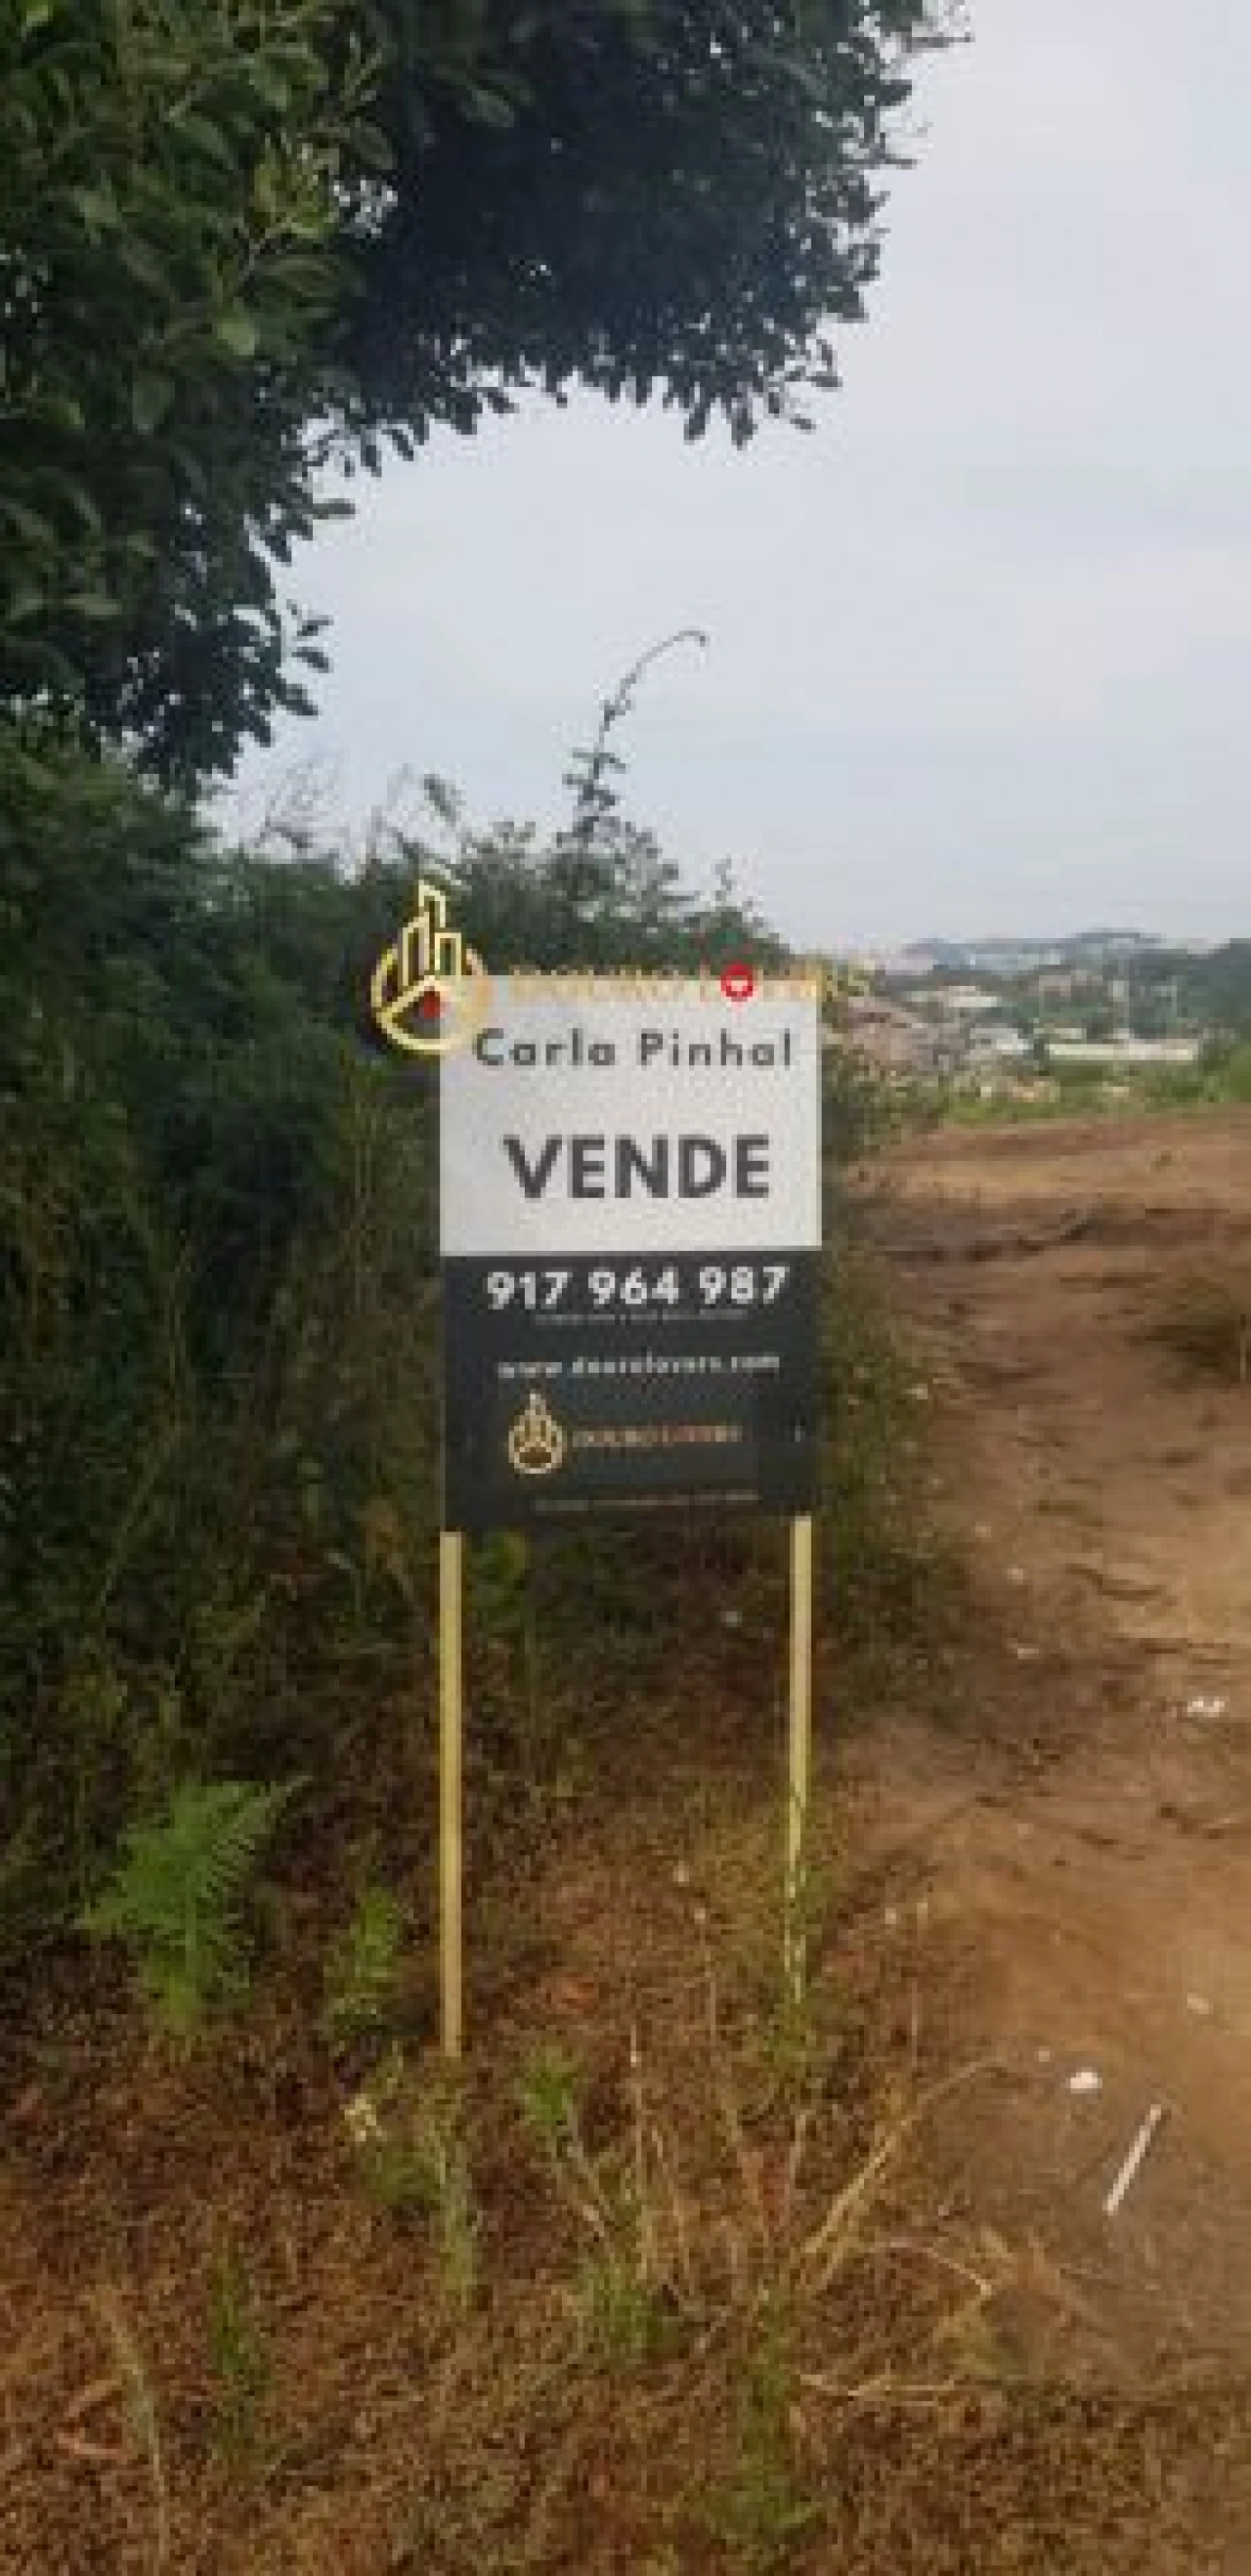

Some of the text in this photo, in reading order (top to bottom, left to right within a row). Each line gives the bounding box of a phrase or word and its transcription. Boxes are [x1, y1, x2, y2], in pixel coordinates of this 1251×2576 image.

[473, 1025, 794, 1067] Carla Pinhal
[502, 1134, 771, 1199] VENDE
[486, 1265, 791, 1310] 917 964 987
